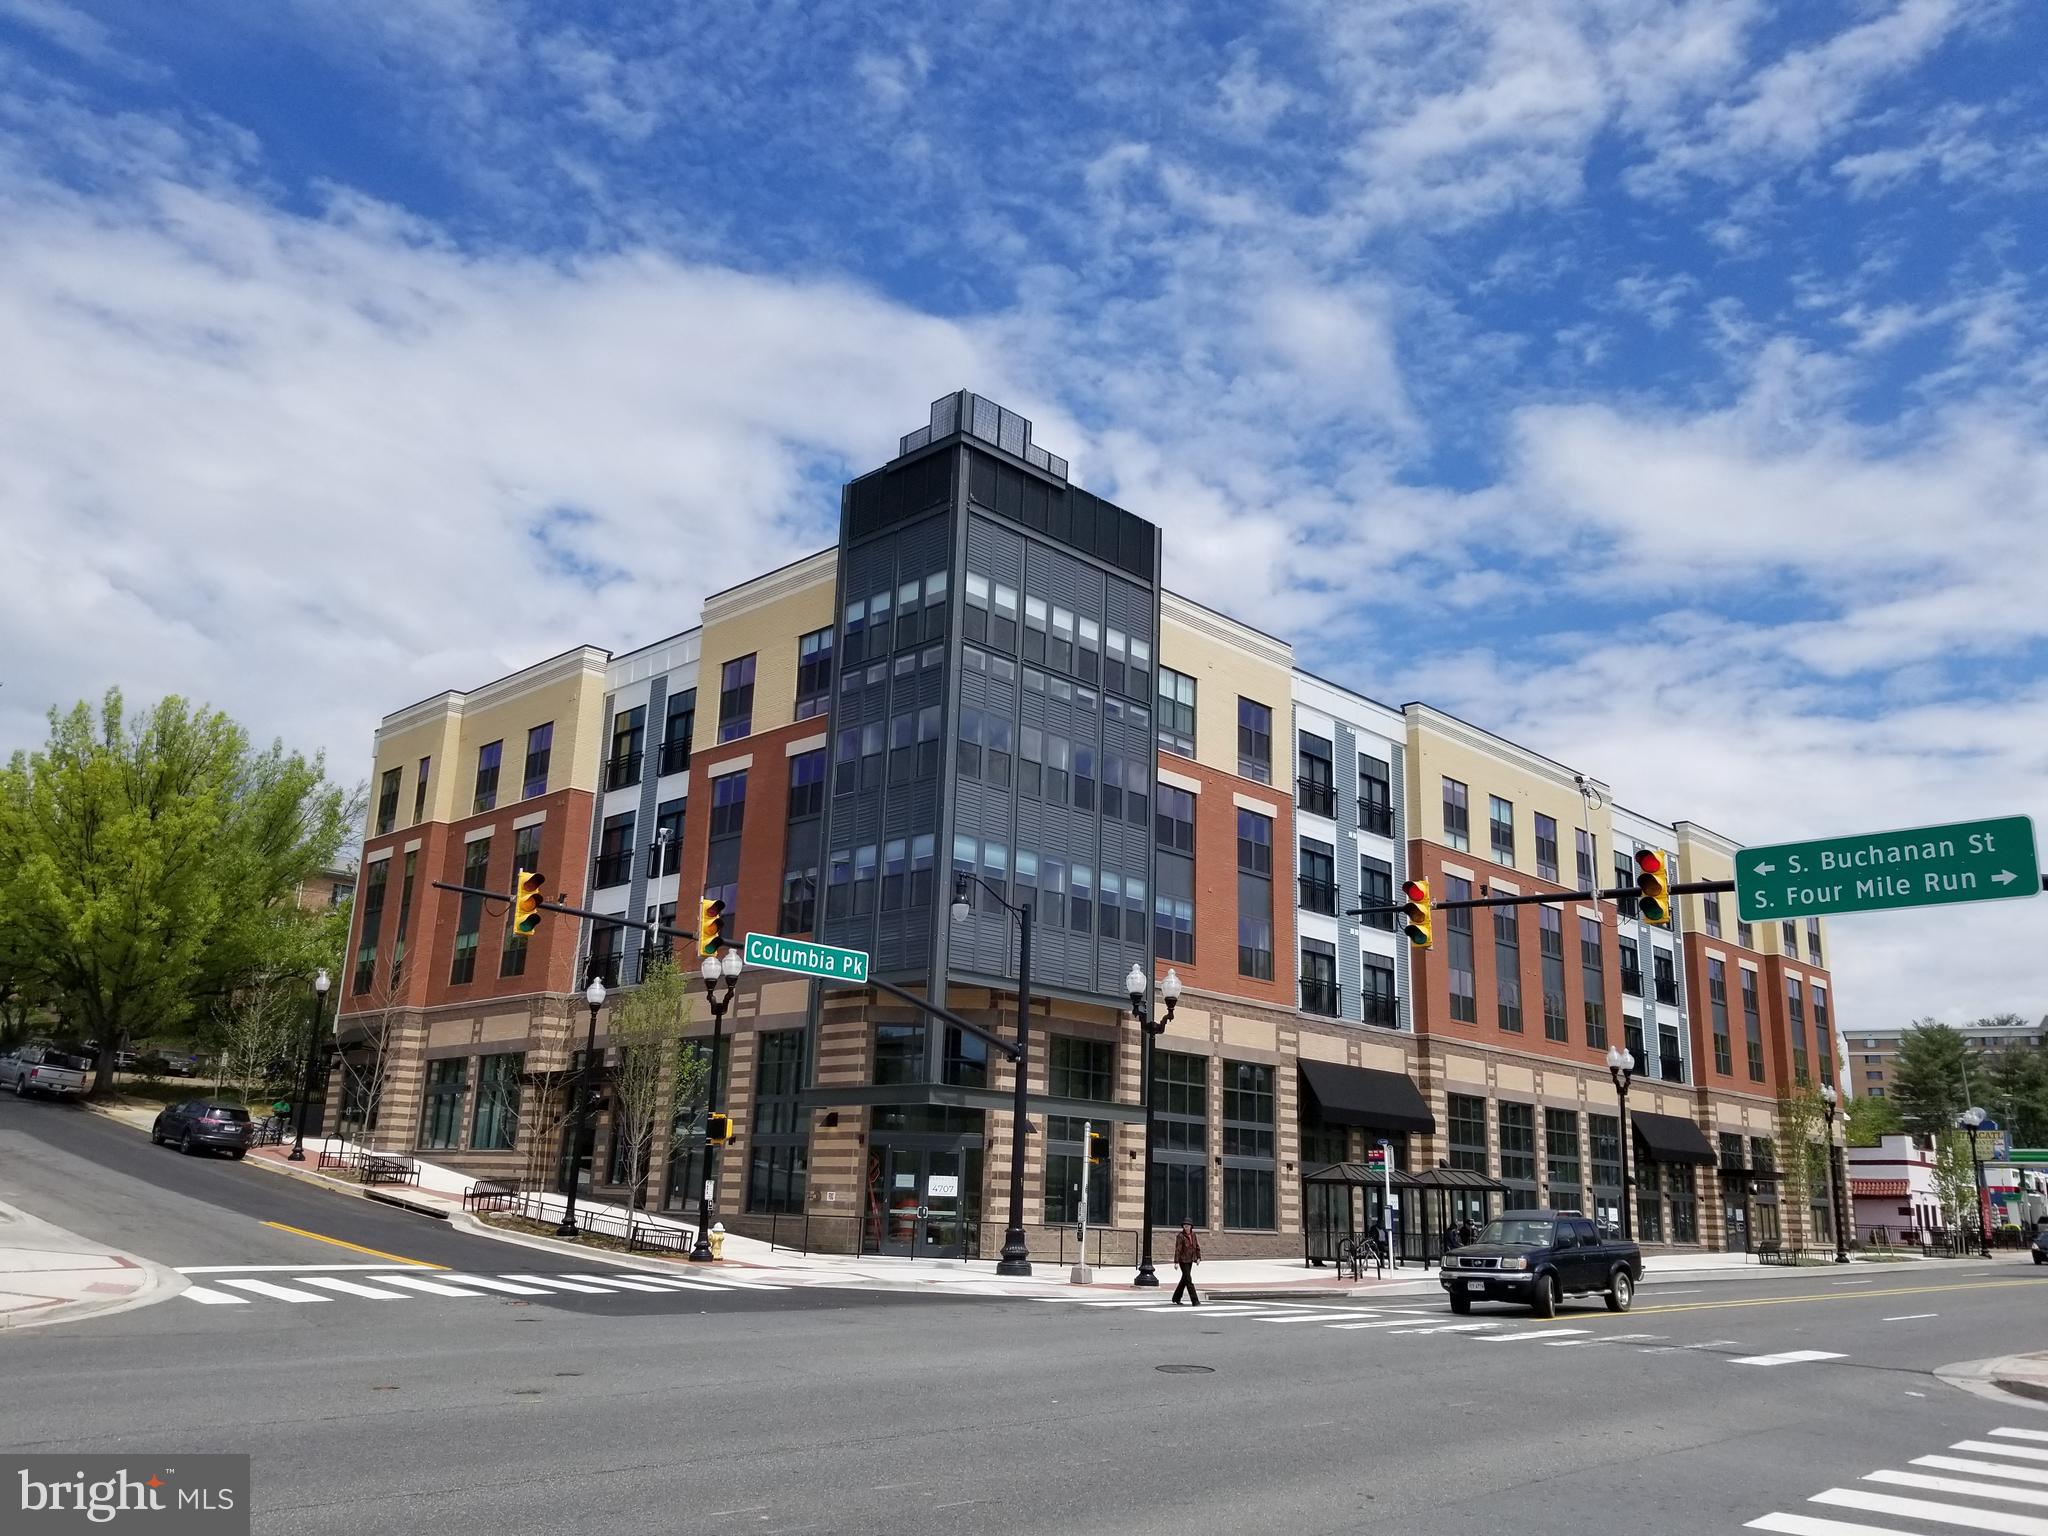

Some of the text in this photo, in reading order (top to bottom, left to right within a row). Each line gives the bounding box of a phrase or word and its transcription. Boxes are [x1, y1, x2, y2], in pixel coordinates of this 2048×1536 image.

[1788, 832, 1996, 874] S. Buchanan St
[1754, 871, 1977, 909] S. Four Mile Run
[750, 941, 863, 975] Columbia Pk
[932, 1185, 954, 1193] 4707
